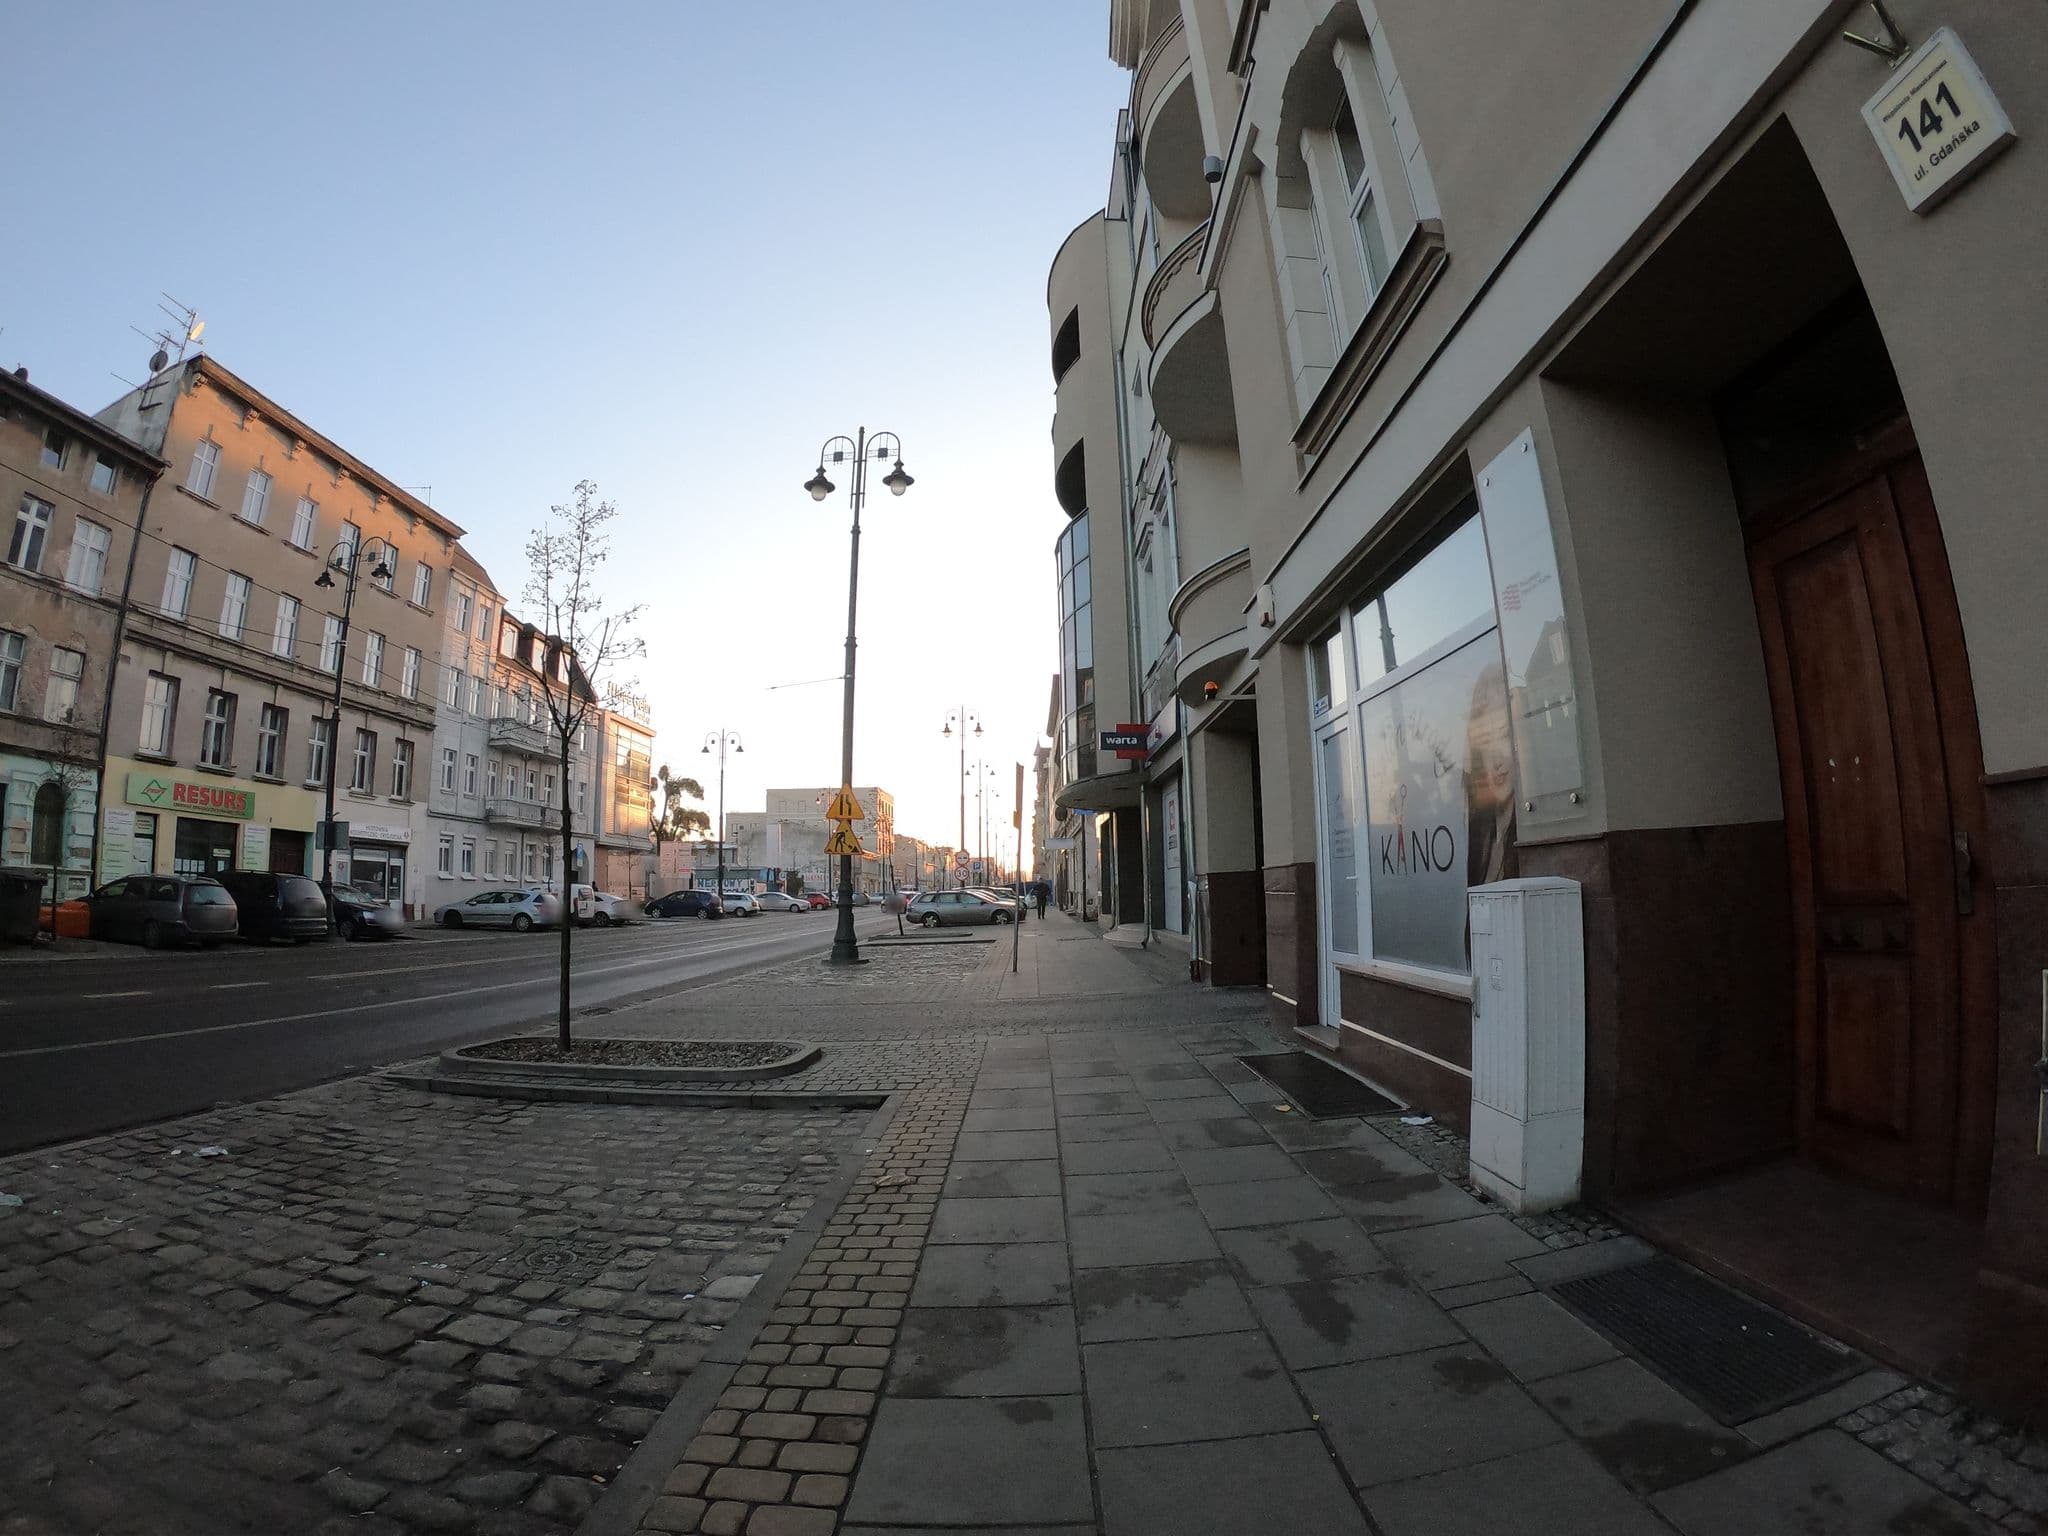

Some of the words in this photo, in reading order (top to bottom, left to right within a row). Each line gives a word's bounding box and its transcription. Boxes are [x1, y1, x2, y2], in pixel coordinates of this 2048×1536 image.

[1898, 80, 1961, 152] 141
[1914, 164, 1929, 181] ul.
[1929, 119, 1981, 166] Gdańska
[1104, 736, 1138, 745] warta
[173, 782, 247, 813] RESURS
[1380, 824, 1455, 876] KANO
